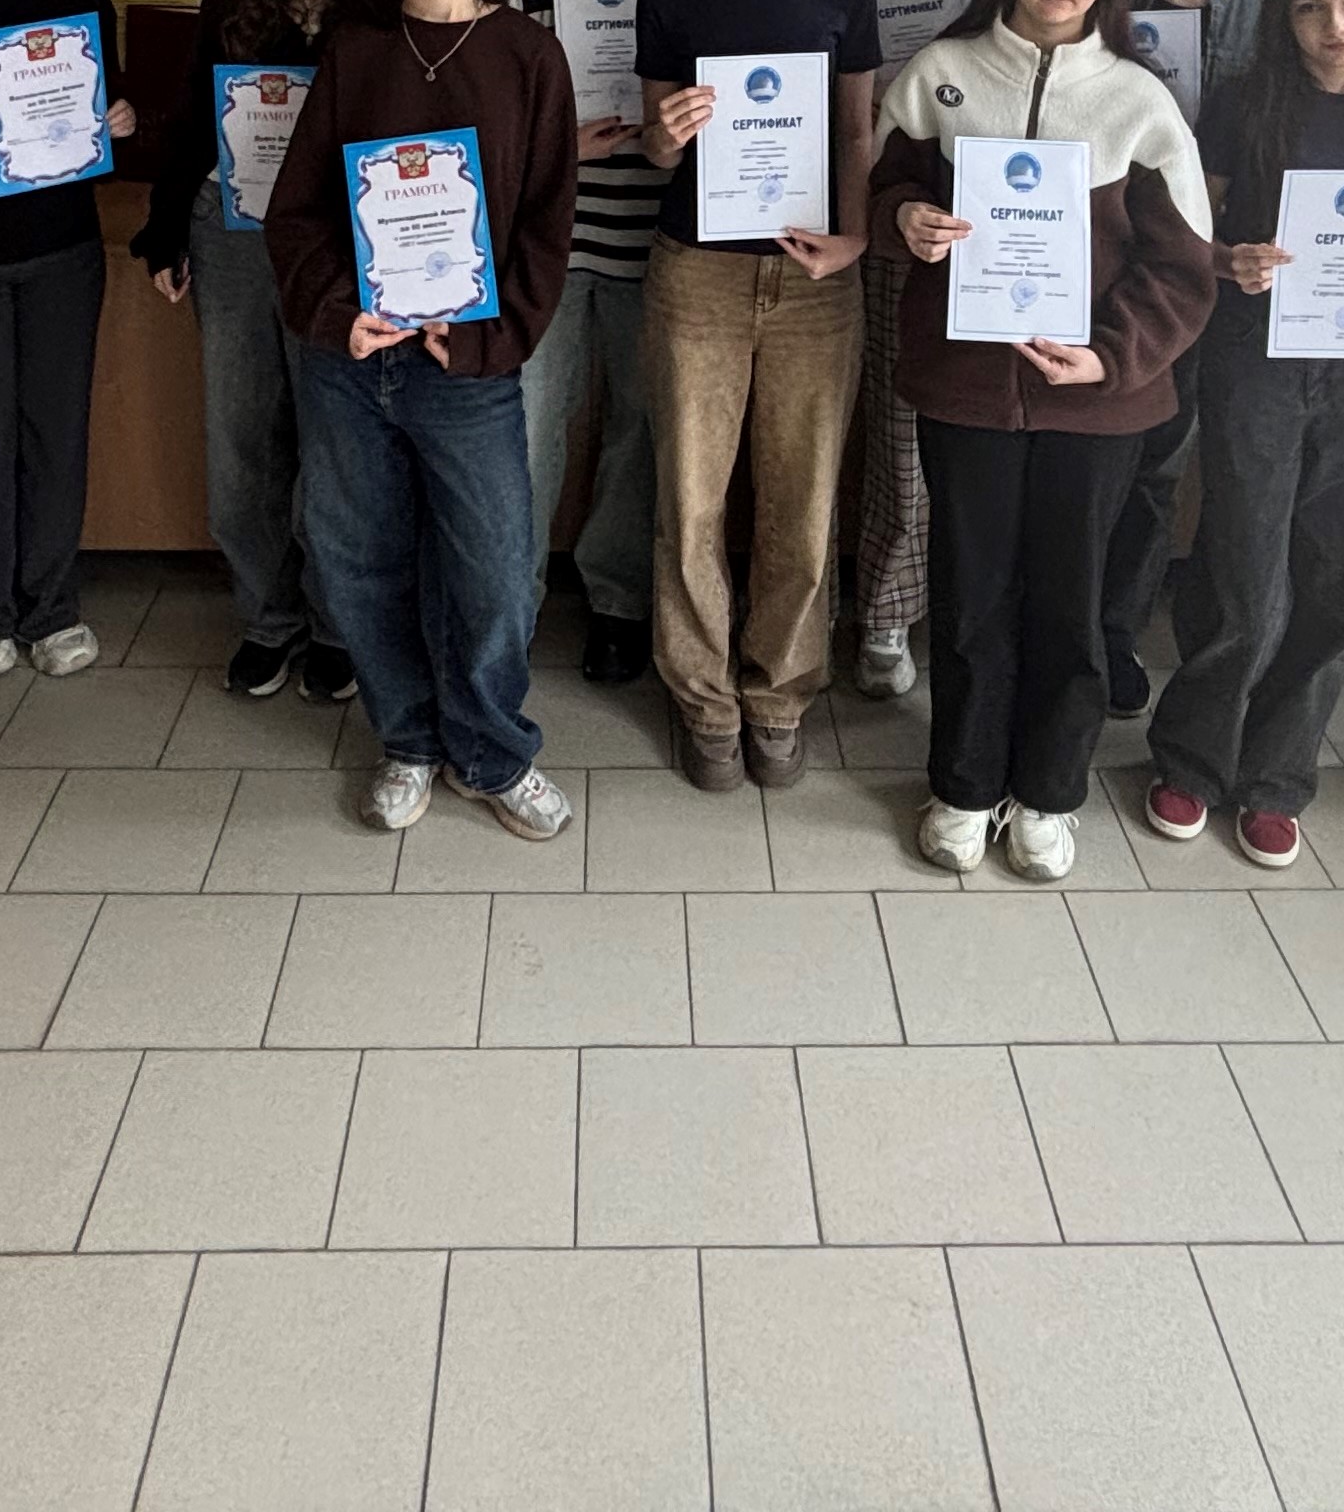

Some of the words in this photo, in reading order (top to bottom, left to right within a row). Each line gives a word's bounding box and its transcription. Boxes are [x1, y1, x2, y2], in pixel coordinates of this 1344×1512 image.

[878, 0, 944, 19] СЕРТИФИКАТ
[585, 19, 635, 31] СЕРТИФИК
[12, 61, 73, 82] ГРАМОТА
[48, 95, 71, 104] место
[246, 111, 297, 122] ГРАМОТ
[732, 116, 803, 131] СЕРТИФИКАТ
[385, 183, 449, 202] ГРАМОТА
[990, 207, 1064, 222] СЕРТИФИКАТ
[422, 221, 448, 229] место
